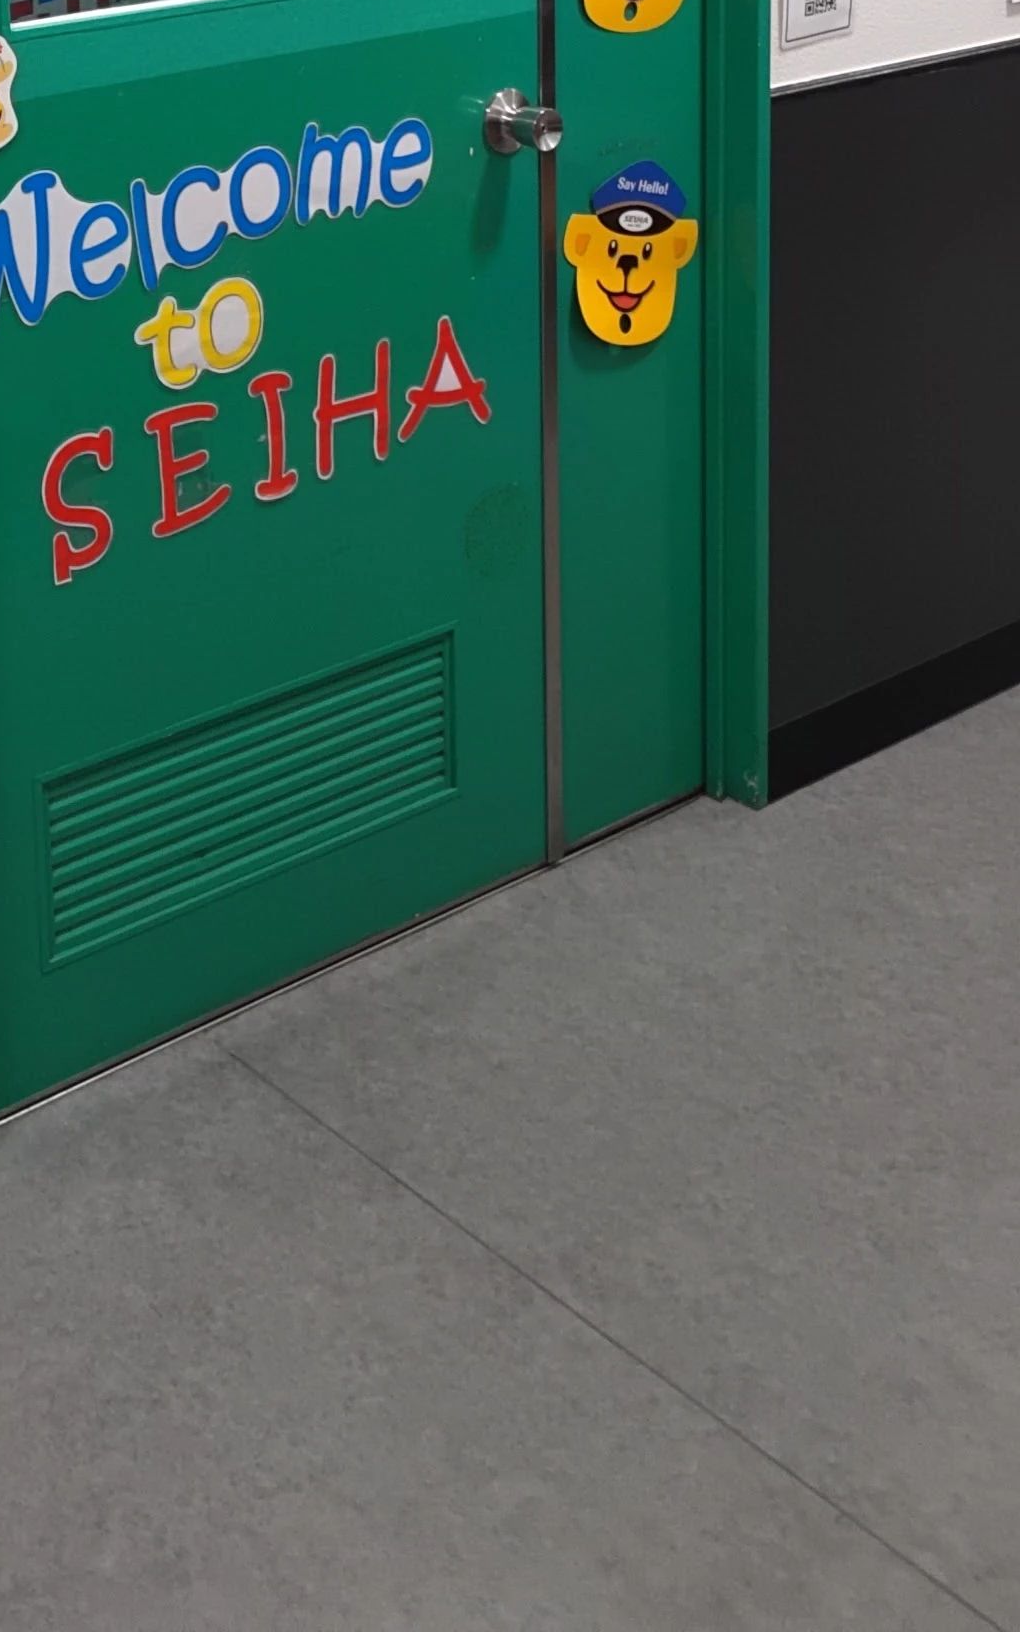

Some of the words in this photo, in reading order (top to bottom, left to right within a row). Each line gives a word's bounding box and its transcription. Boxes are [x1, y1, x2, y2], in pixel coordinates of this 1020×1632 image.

[617, 177, 636, 192] Say
[638, 179, 669, 195] Hello!
[137, 279, 263, 387] to
[43, 316, 491, 584] SEIHA
